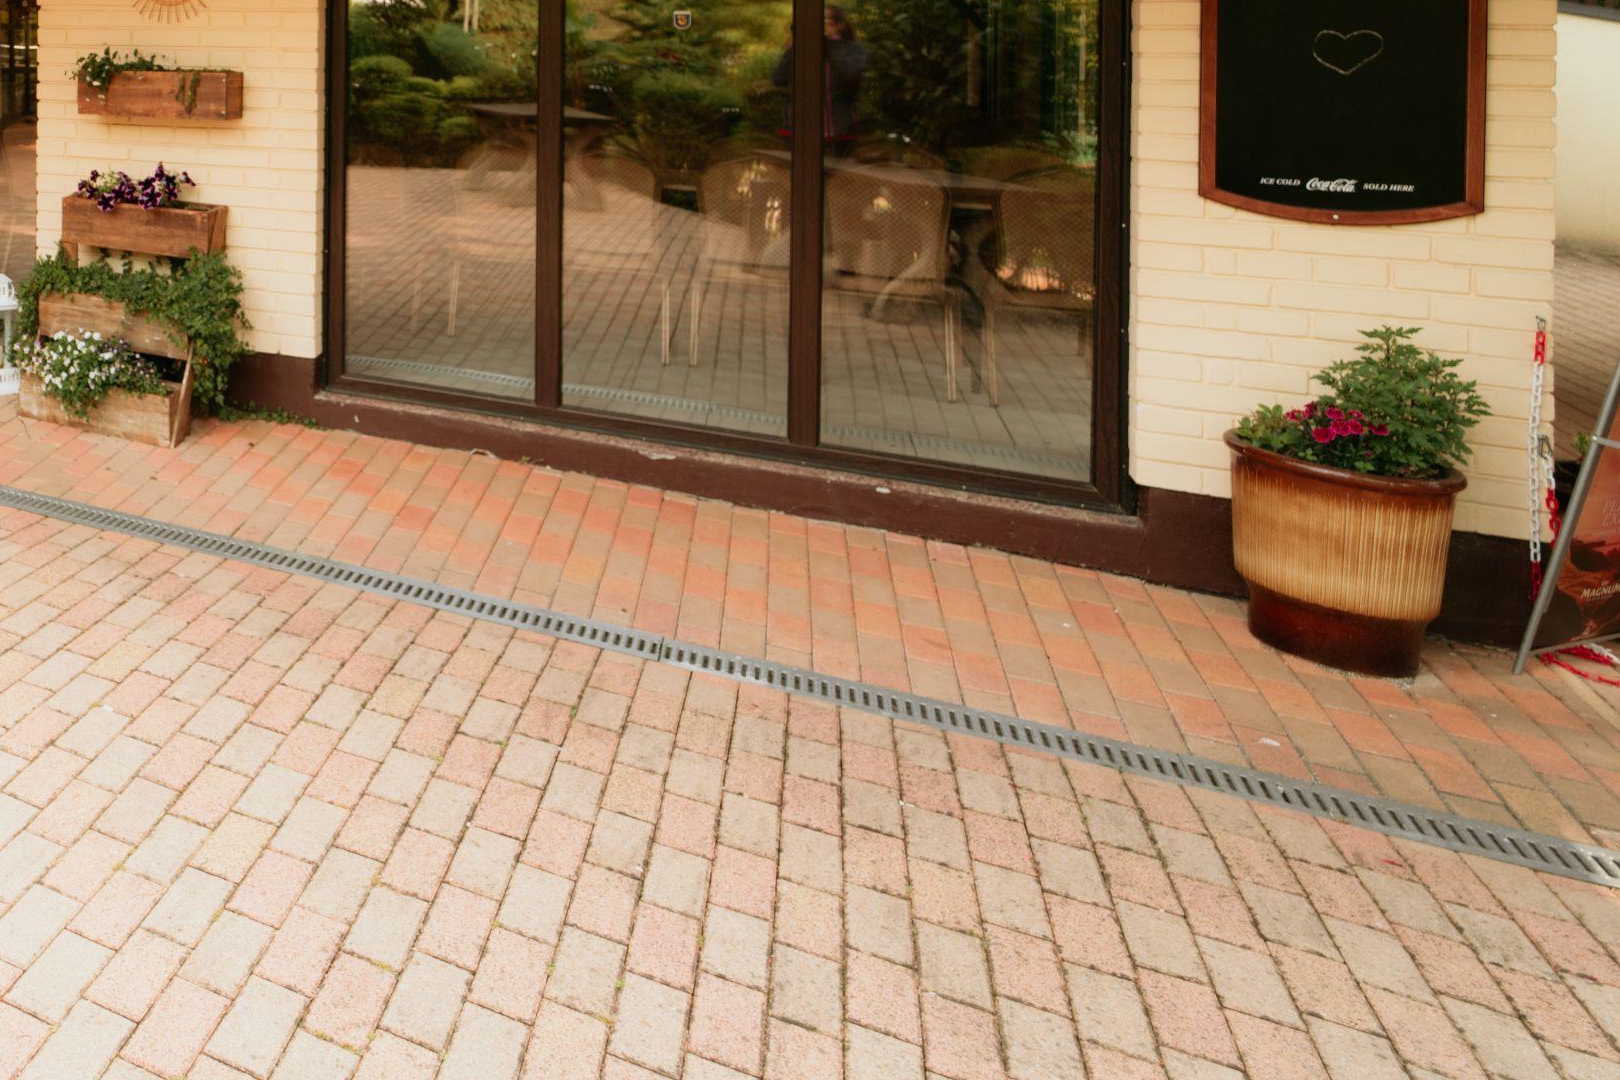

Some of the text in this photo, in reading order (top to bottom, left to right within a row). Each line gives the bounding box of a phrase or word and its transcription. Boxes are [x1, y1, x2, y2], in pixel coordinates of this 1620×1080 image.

[1259, 176, 1415, 193] ICE COLD Coca-Cola SOLD HERE
